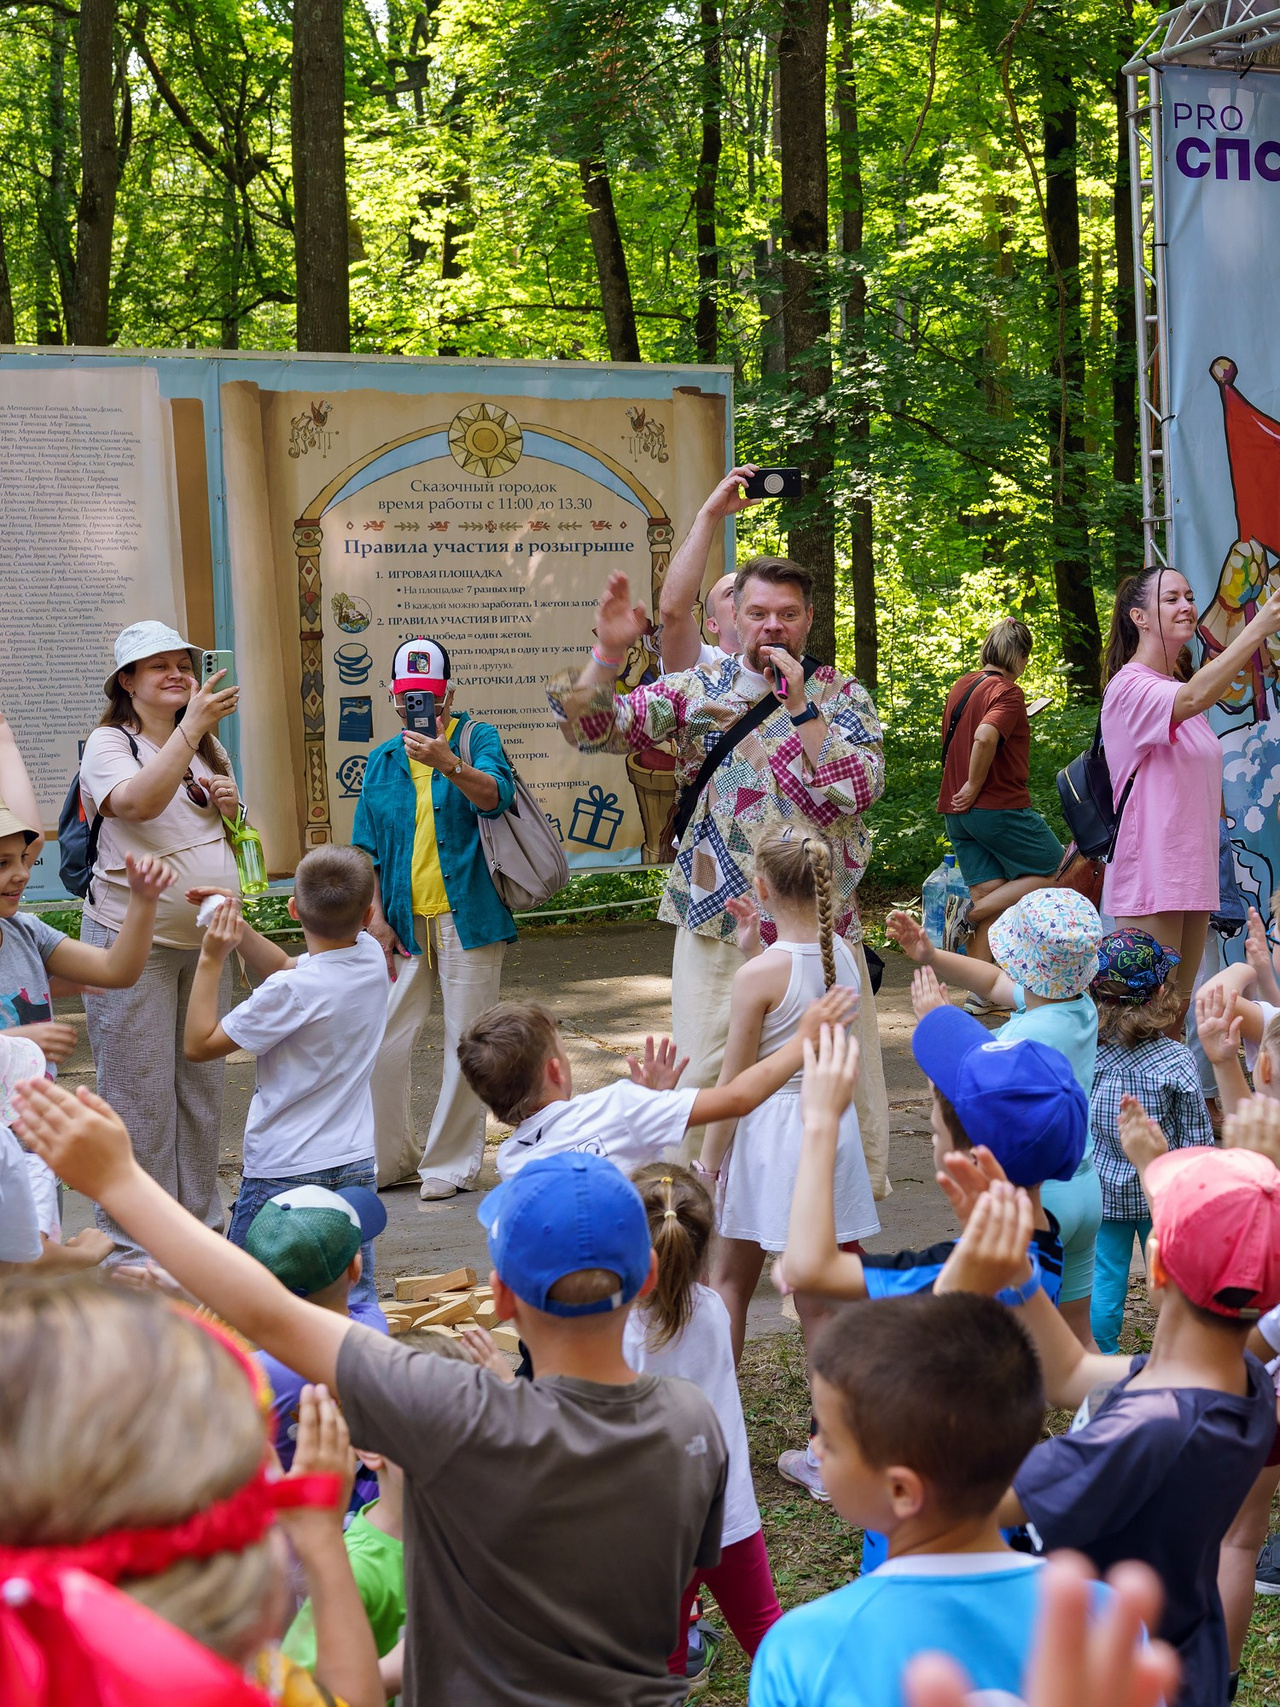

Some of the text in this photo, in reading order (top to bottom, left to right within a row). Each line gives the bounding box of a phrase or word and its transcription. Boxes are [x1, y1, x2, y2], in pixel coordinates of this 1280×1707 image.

[1173, 102, 1243, 131] PRO
[410, 480, 557, 496] Сказочный городок
[378, 497, 593, 512] время работы с 11:00 до 13.30
[344, 539, 635, 558] Правила участия в розыгрыше
[376, 569, 503, 579] 1. ИГРОВАЯ ПЛОЩАДКА
[404, 585, 526, 595] На площадке 7 разных игр
[404, 601, 410, 609] В
[412, 601, 446, 610] каждой
[448, 601, 479, 609] можно
[480, 600, 532, 610] заработать
[540, 600, 569, 608] жетон
[388, 616, 439, 625] ПРАВИЛА
[441, 616, 490, 625] УЧАСТИЯ
[499, 615, 532, 623] ИГРАХ
[432, 632, 466, 641] победа
[474, 632, 498, 640] один
[475, 647, 509, 656] подряд
[518, 646, 544, 655] одну
[551, 645, 561, 654] ту
[472, 662, 478, 670] в
[479, 661, 513, 672] другую.
[378, 680, 386, 688] 3.
[457, 675, 513, 686] КАРТОЧКИ
[515, 675, 537, 684] ДЛЯ
[469, 707, 474, 715] 5
[476, 707, 518, 716] жетонов,
[519, 706, 549, 715] отнеси
[537, 779, 589, 791] суперприза
